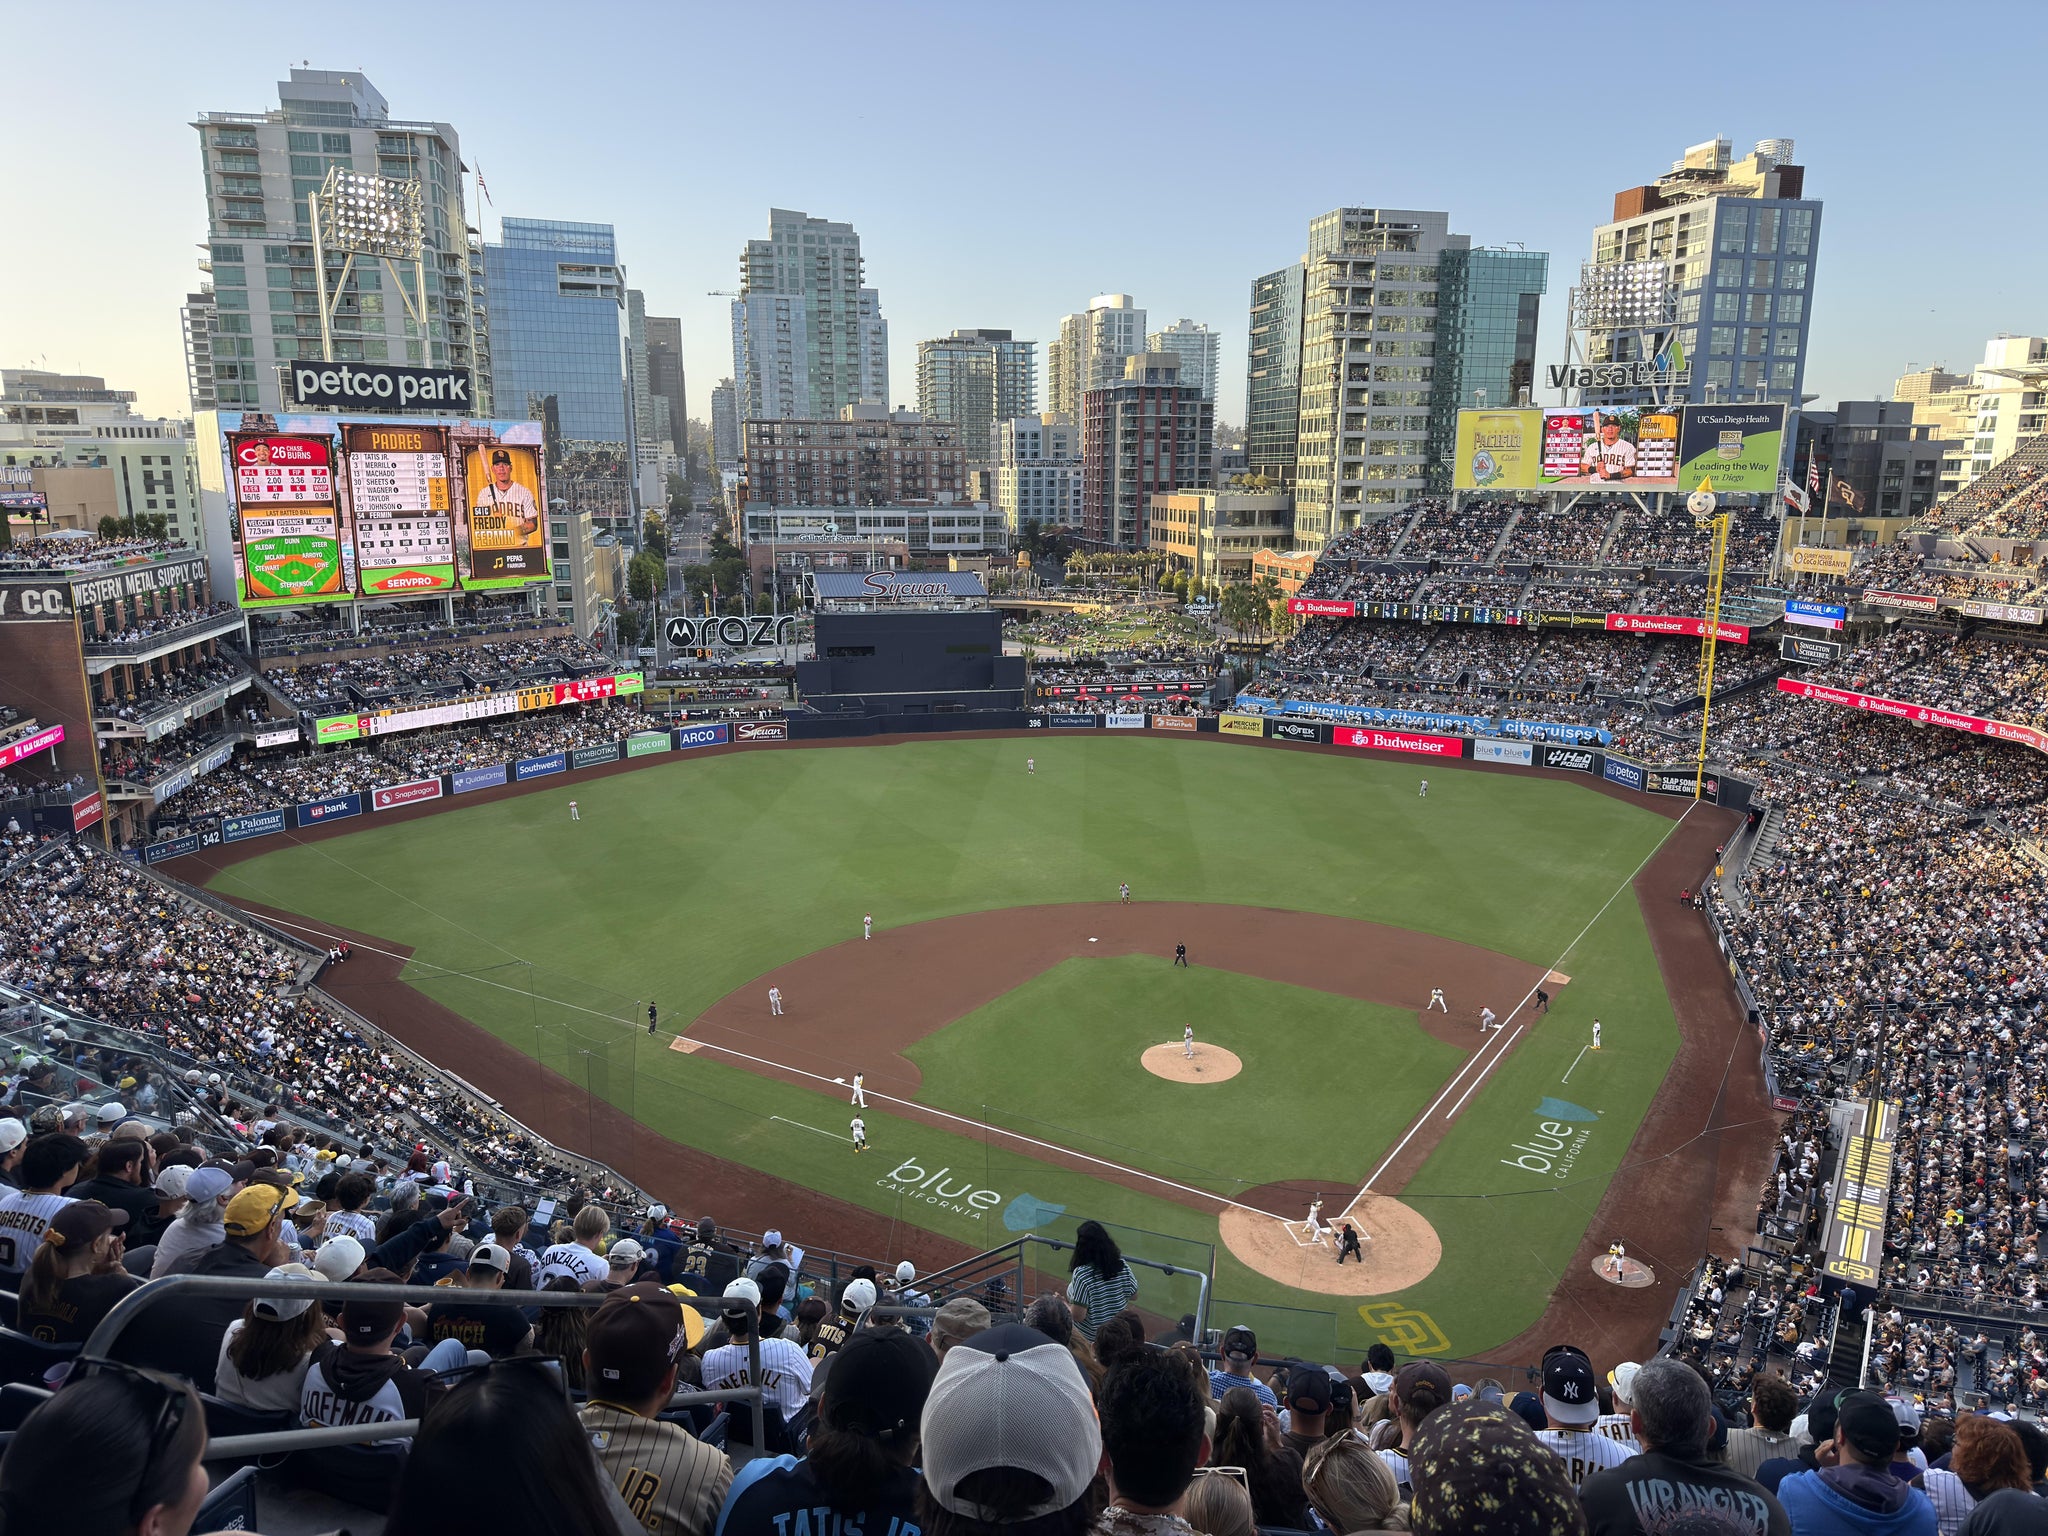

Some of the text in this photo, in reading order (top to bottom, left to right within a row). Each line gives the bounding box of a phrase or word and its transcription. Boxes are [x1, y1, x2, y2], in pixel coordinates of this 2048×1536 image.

[1550, 362, 1644, 387] Viasat
[296, 366, 467, 406] petco park
[1697, 415, 1770, 425] UC San Diego Health
[372, 432, 422, 450] PADRES
[272, 446, 286, 458] 26
[287, 452, 311, 460] BURNS
[1694, 462, 1730, 471] Leading
[1749, 462, 1769, 472] Way
[1722, 474, 1744, 482] Diego
[474, 517, 506, 530] FREDDY
[475, 530, 515, 546] FERMIN
[72, 561, 206, 606] WESTERN METAL SUPPLY CO.
[388, 577, 431, 587] SERVPRO
[862, 571, 952, 603] Sycuan
[21, 590, 72, 615] CO.
[1307, 603, 1348, 613] Budweiser
[1864, 591, 1934, 610] Tarantino SAUSAGES
[2007, 608, 2035, 622] $8,325
[700, 615, 795, 647] razr
[1631, 619, 1742, 640] Budweiser Bdweiser
[1800, 642, 1830, 652] SINGLETON
[1814, 689, 1972, 730] Budweiser Budweiser Budweiser
[682, 731, 714, 744] ARCO
[739, 724, 782, 739] Sycuan
[1278, 725, 1315, 735] EVOTEK
[1374, 734, 1444, 752] Budweiser
[1504, 749, 1522, 757] blue
[519, 760, 558, 774] Southwest
[1560, 761, 1589, 769] POWER
[465, 771, 504, 785] QuidelOrtho
[1616, 766, 1638, 780] petco
[395, 785, 434, 800] Snapdragon
[312, 802, 348, 816] us bank
[240, 815, 281, 830] Palomar
[228, 823, 282, 838] SPECIALTY INSURANCE
[203, 831, 220, 846] 342
[1500, 1122, 1572, 1174] blue
[1554, 1130, 1591, 1179] CALIFORNIA
[886, 1157, 1001, 1210] blue
[876, 1180, 982, 1220] CALIFORNIA
[541, 1252, 589, 1278] GONZALEZ
[684, 1256, 707, 1277] 23
[819, 1324, 846, 1345] TATIS
[720, 1369, 782, 1390] MERILL
[1626, 1479, 1770, 1533] WRANGLER
